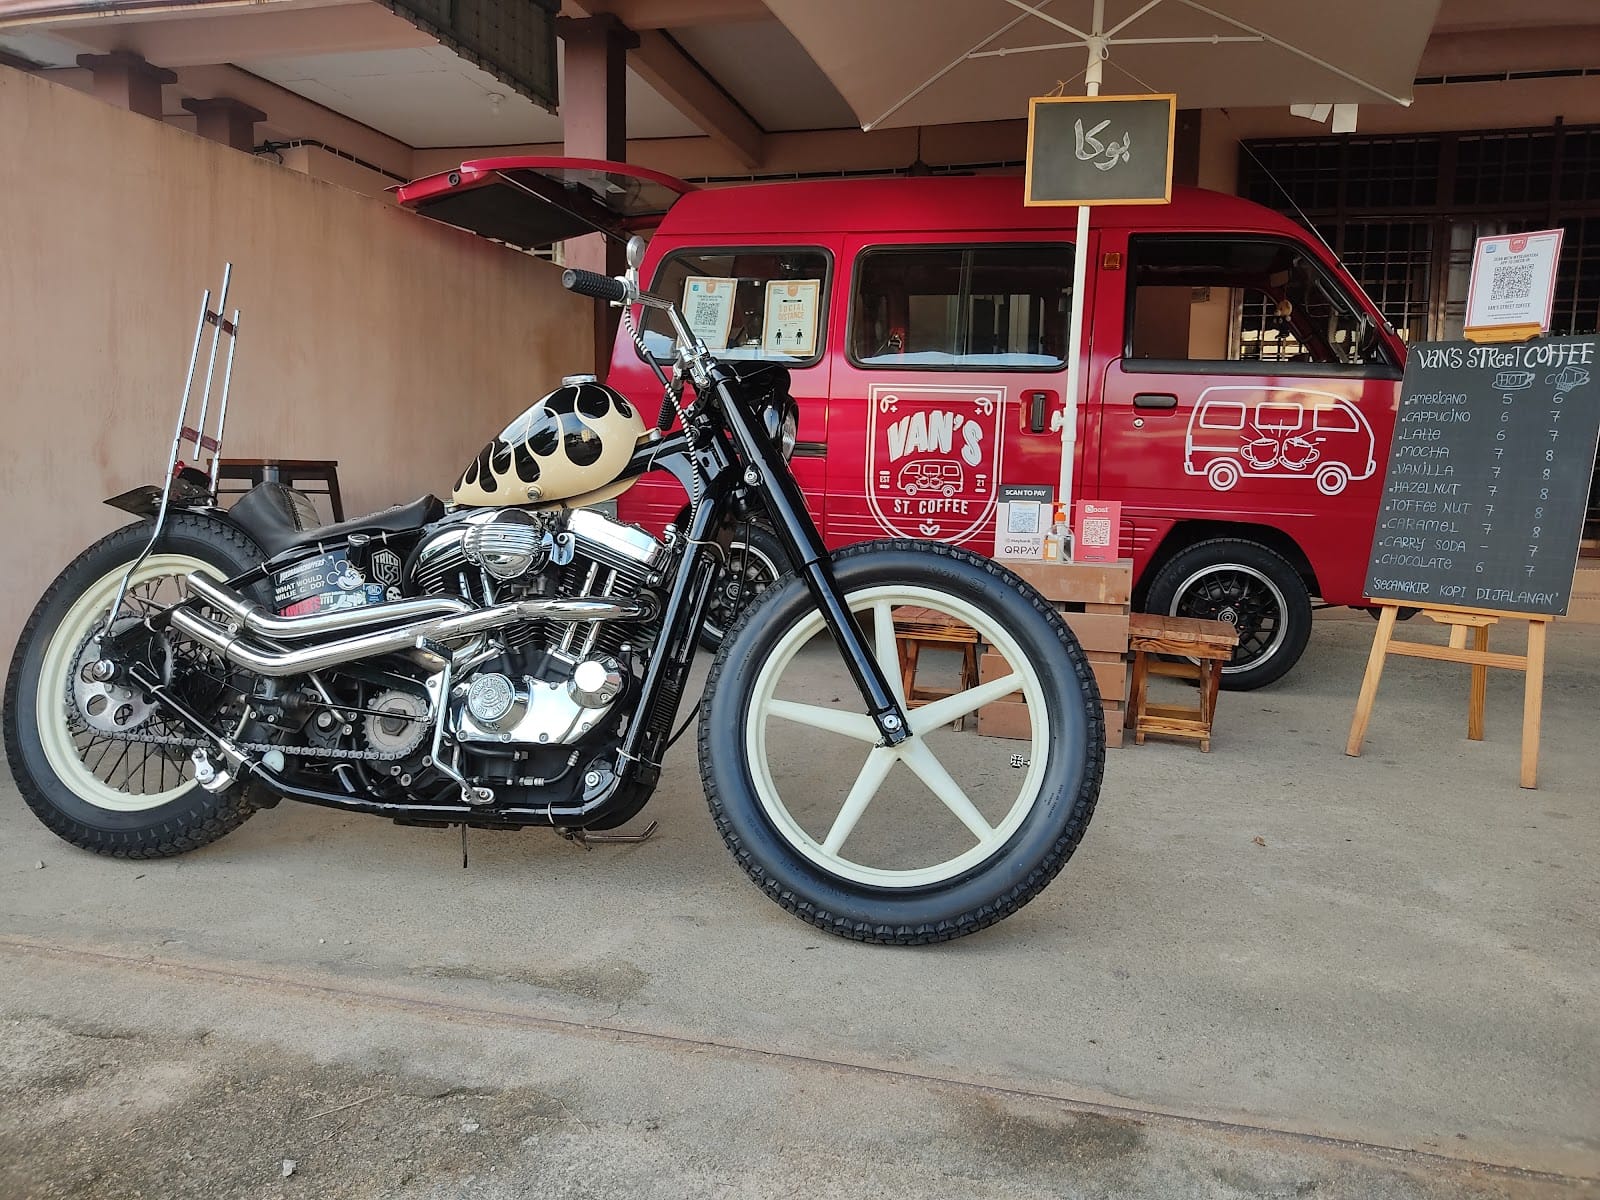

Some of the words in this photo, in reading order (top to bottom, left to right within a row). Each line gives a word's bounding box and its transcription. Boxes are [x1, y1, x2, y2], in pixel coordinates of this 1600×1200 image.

[1524, 342, 1595, 368] COFFEE
[1500, 374, 1526, 386] HOT
[1502, 393, 1513, 405] 5
[1553, 392, 1564, 404] 6
[1500, 411, 1509, 422] 6
[1550, 410, 1561, 422] 7
[887, 410, 983, 467] VAN'S
[1496, 429, 1506, 441] 6
[1549, 430, 1559, 442] 7
[1400, 446, 1450, 458] MOCHA
[1494, 448, 1504, 460] 7
[1545, 449, 1554, 462] 8
[1490, 466, 1501, 479] 7
[1542, 468, 1551, 480] 8
[976, 479, 985, 487] 21
[1487, 485, 1498, 497] 7
[1540, 488, 1549, 500] 8
[894, 499, 913, 515] ST.
[918, 499, 968, 515] COFFEE
[1442, 502, 1473, 514] NUT
[1485, 504, 1495, 517] 7
[1535, 507, 1544, 519] 8
[1482, 523, 1492, 535] 7
[1533, 526, 1541, 538] 8
[1004, 545, 1039, 555] QRPAY
[1384, 536, 1426, 552] CARRY
[1435, 539, 1466, 553] SODA
[1528, 544, 1538, 557] 7
[1475, 561, 1485, 573] 6
[1525, 565, 1536, 577] 7
[275, 583, 296, 594] WHAT
[296, 574, 323, 587] WOULD
[275, 590, 297, 602] WILLIE
[310, 581, 326, 590] DO?
[1440, 585, 1467, 598] KOPI
